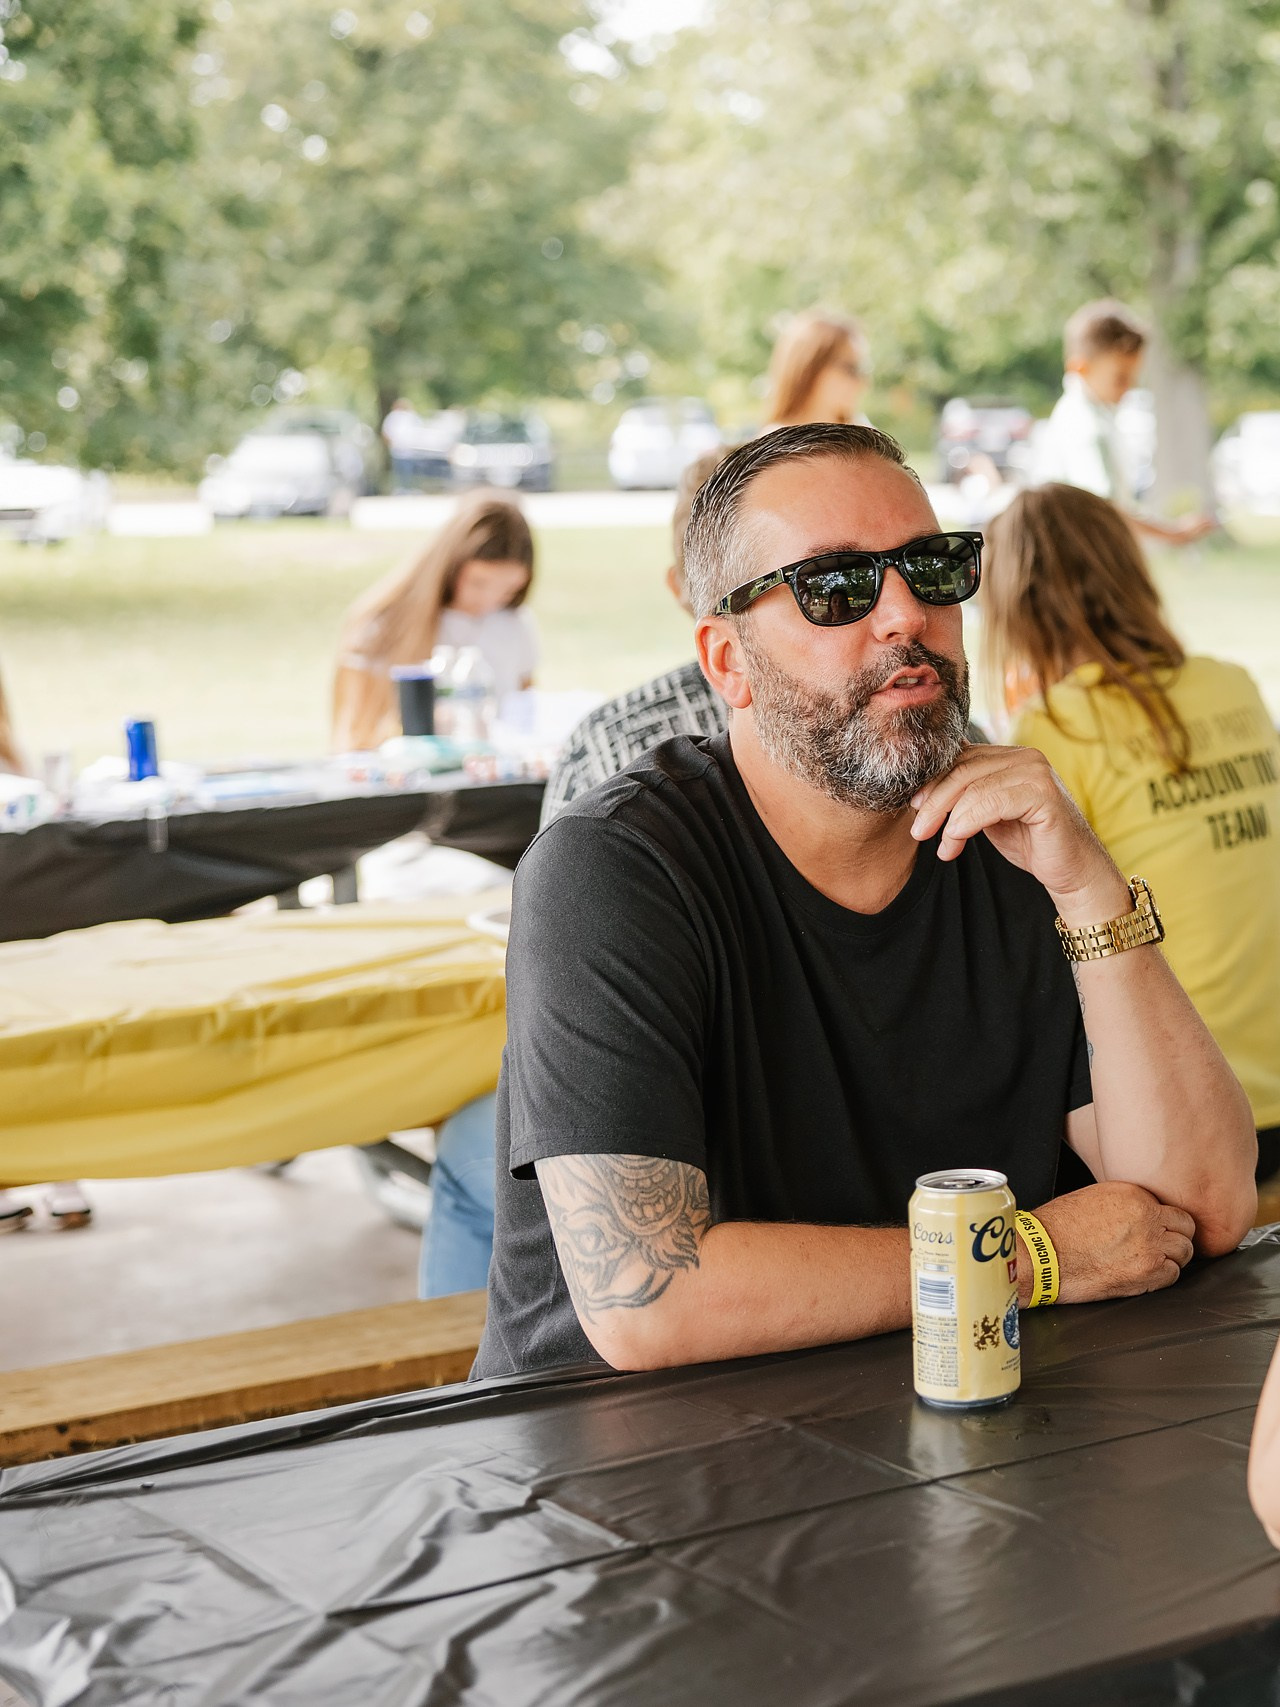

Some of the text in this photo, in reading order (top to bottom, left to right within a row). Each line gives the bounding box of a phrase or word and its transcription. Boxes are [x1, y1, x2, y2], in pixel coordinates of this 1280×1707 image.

[1206, 804, 1270, 851] TEAM
[913, 1222, 954, 1244] Coors
[969, 1215, 1017, 1263] Co
[1031, 1236, 1050, 1265] OCMC
[1041, 1267, 1052, 1291] with
